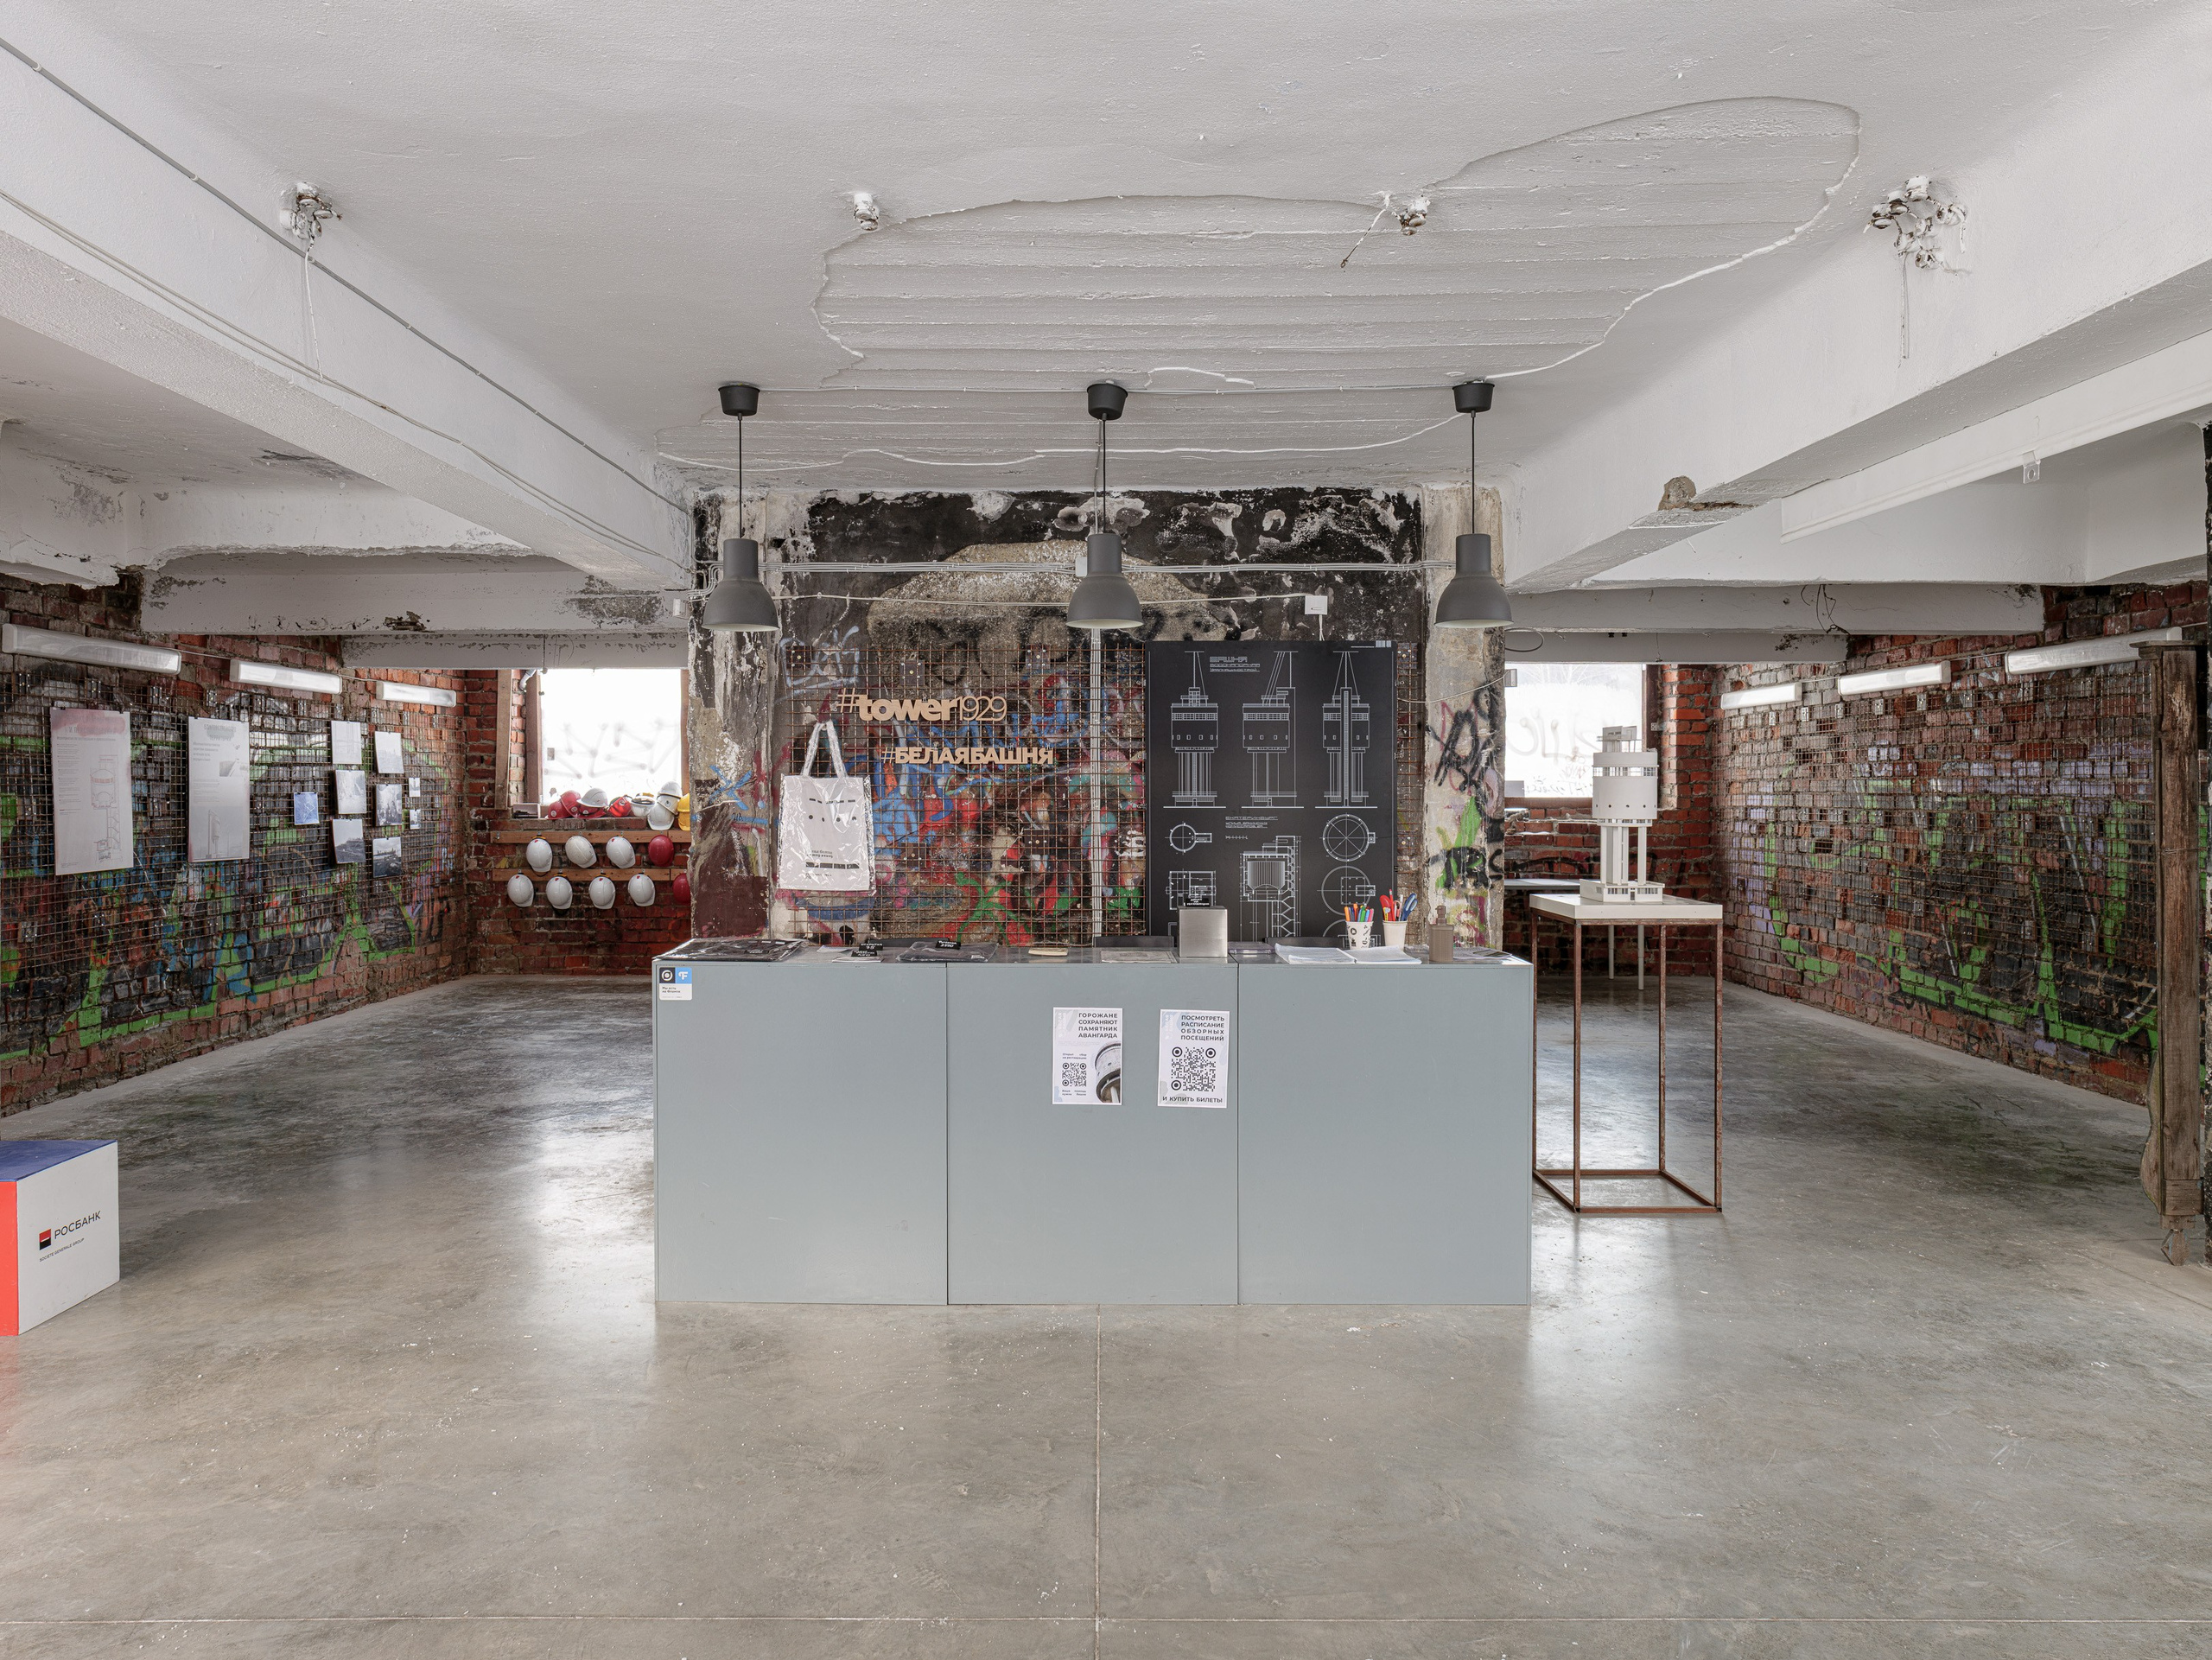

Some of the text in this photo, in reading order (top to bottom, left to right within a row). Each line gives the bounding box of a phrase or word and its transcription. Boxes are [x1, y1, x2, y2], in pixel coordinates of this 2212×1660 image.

[836, 687, 1007, 722] #tower1929
[880, 746, 1053, 765] #БЕЛАЯБАШНЯ
[54, 1210, 102, 1239] РОСБАНК
